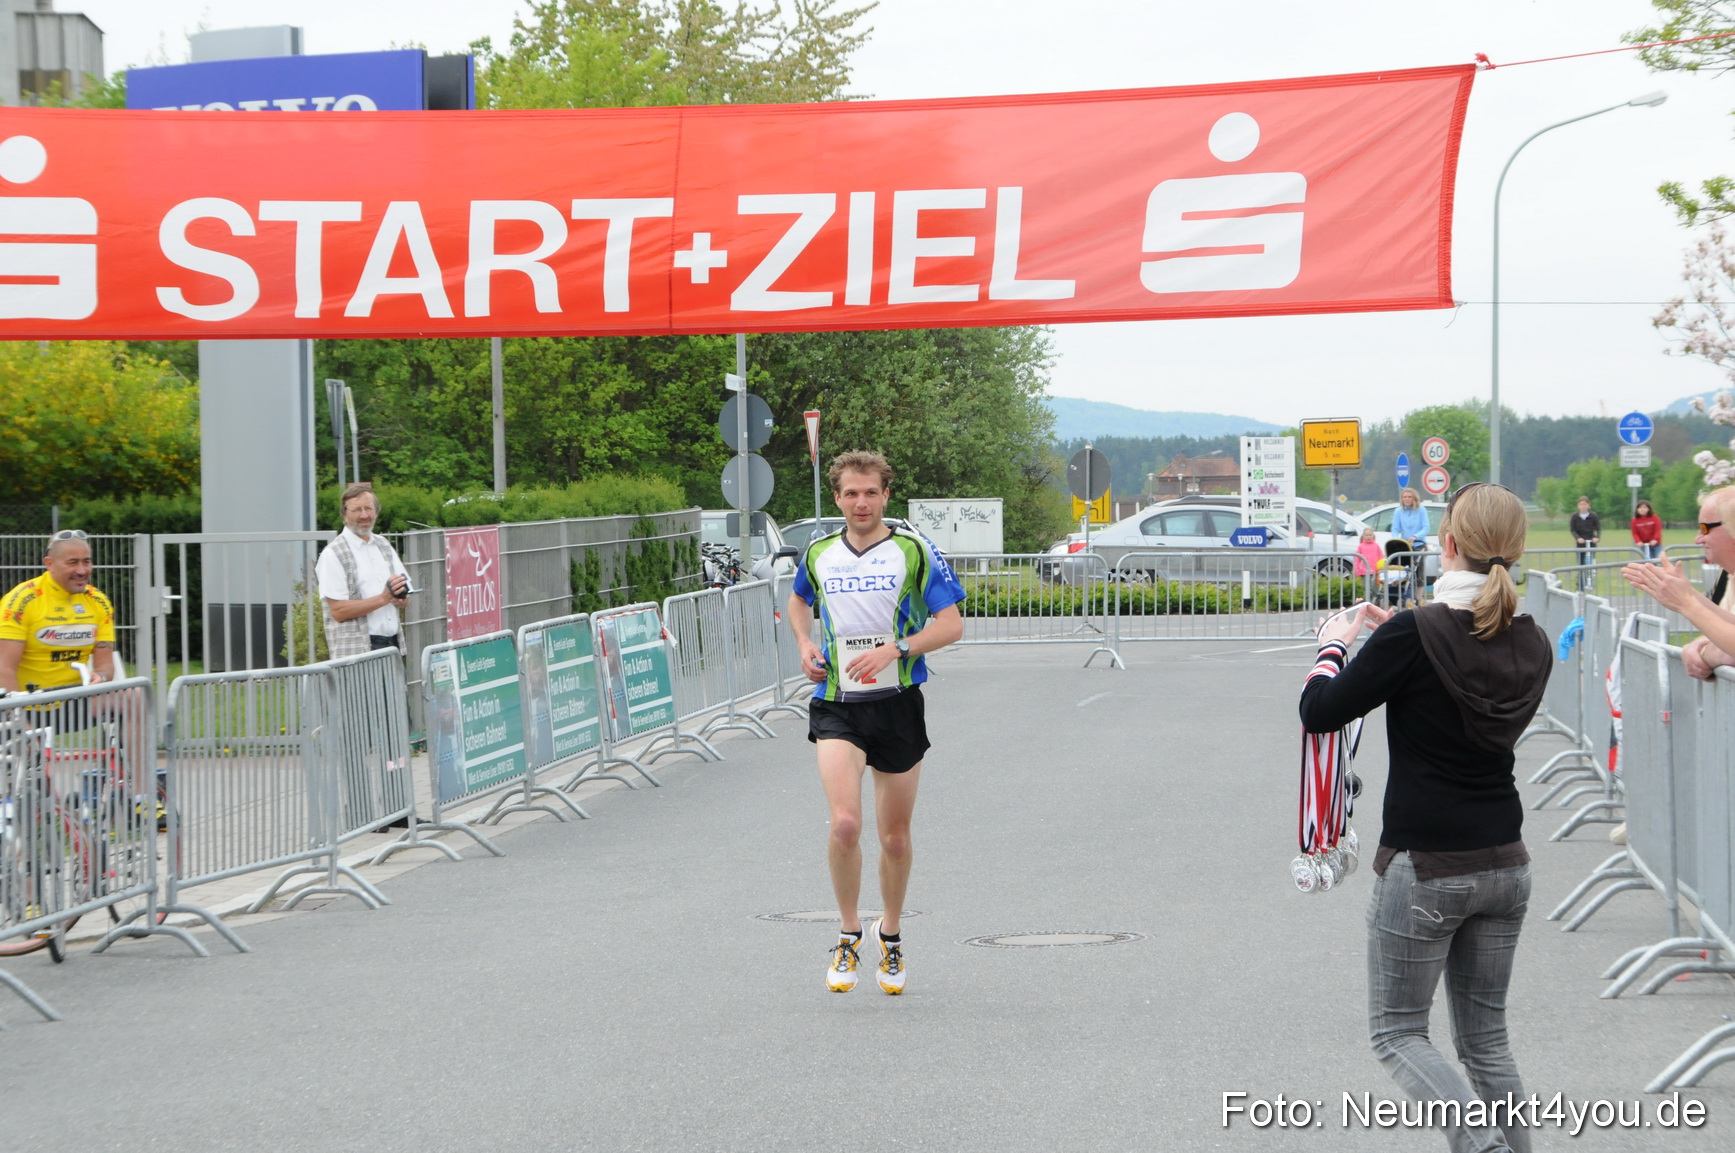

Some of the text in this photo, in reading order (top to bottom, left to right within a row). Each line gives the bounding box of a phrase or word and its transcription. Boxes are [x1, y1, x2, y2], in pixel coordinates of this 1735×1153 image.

[1308, 437, 1355, 449] Neumarkt
[1428, 445, 1444, 458] 60
[1237, 535, 1264, 545] VOLVO
[827, 565, 858, 574] TEAM
[824, 574, 897, 595] BOCK
[455, 581, 496, 617] ZEITLOS
[846, 638, 873, 647] MEYER
[462, 694, 501, 723] Fun & Action in
[465, 729, 486, 753] sicheren
